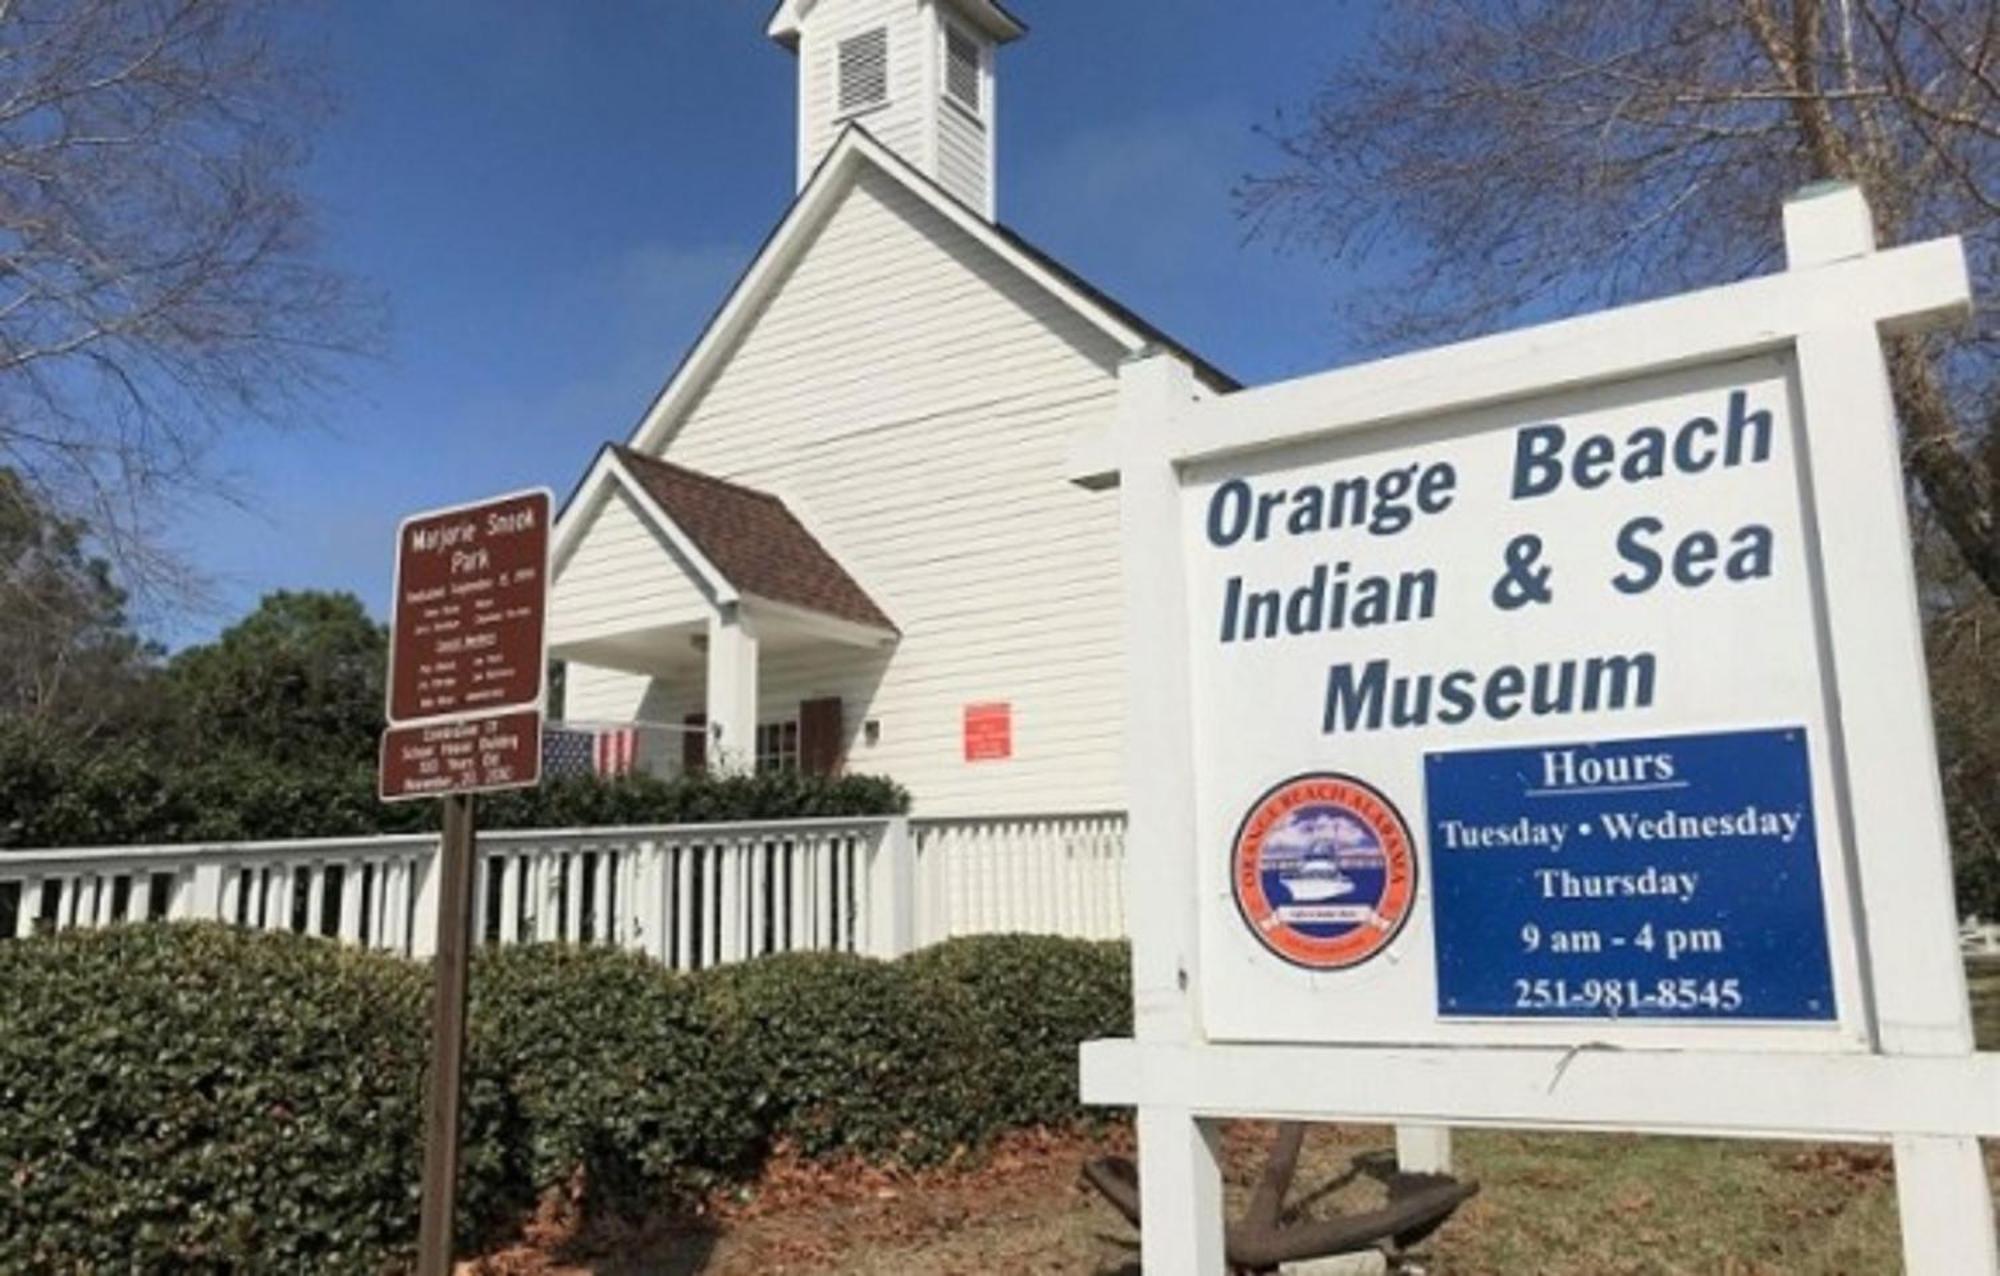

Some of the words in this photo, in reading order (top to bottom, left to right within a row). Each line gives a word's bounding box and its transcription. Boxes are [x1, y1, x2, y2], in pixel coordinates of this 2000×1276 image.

[1205, 459, 1457, 548] Orange
[1510, 390, 1774, 500] Beach
[451, 548, 490, 574] Park
[1219, 561, 1438, 643] Indian
[1491, 533, 1555, 610] &
[1610, 515, 1774, 594] Sea
[1322, 650, 1658, 735] Museum
[1542, 749, 1675, 787] Hours
[1438, 816, 1569, 851] Tuesday
[1600, 805, 1801, 841] Wednesday
[1534, 867, 1699, 901] Thursday
[1521, 923, 1541, 952] 9
[1551, 929, 1602, 952] am
[1634, 923, 1655, 952] 4
[1666, 927, 1723, 959] pm
[1514, 979, 1743, 1010] 251-981-8545
